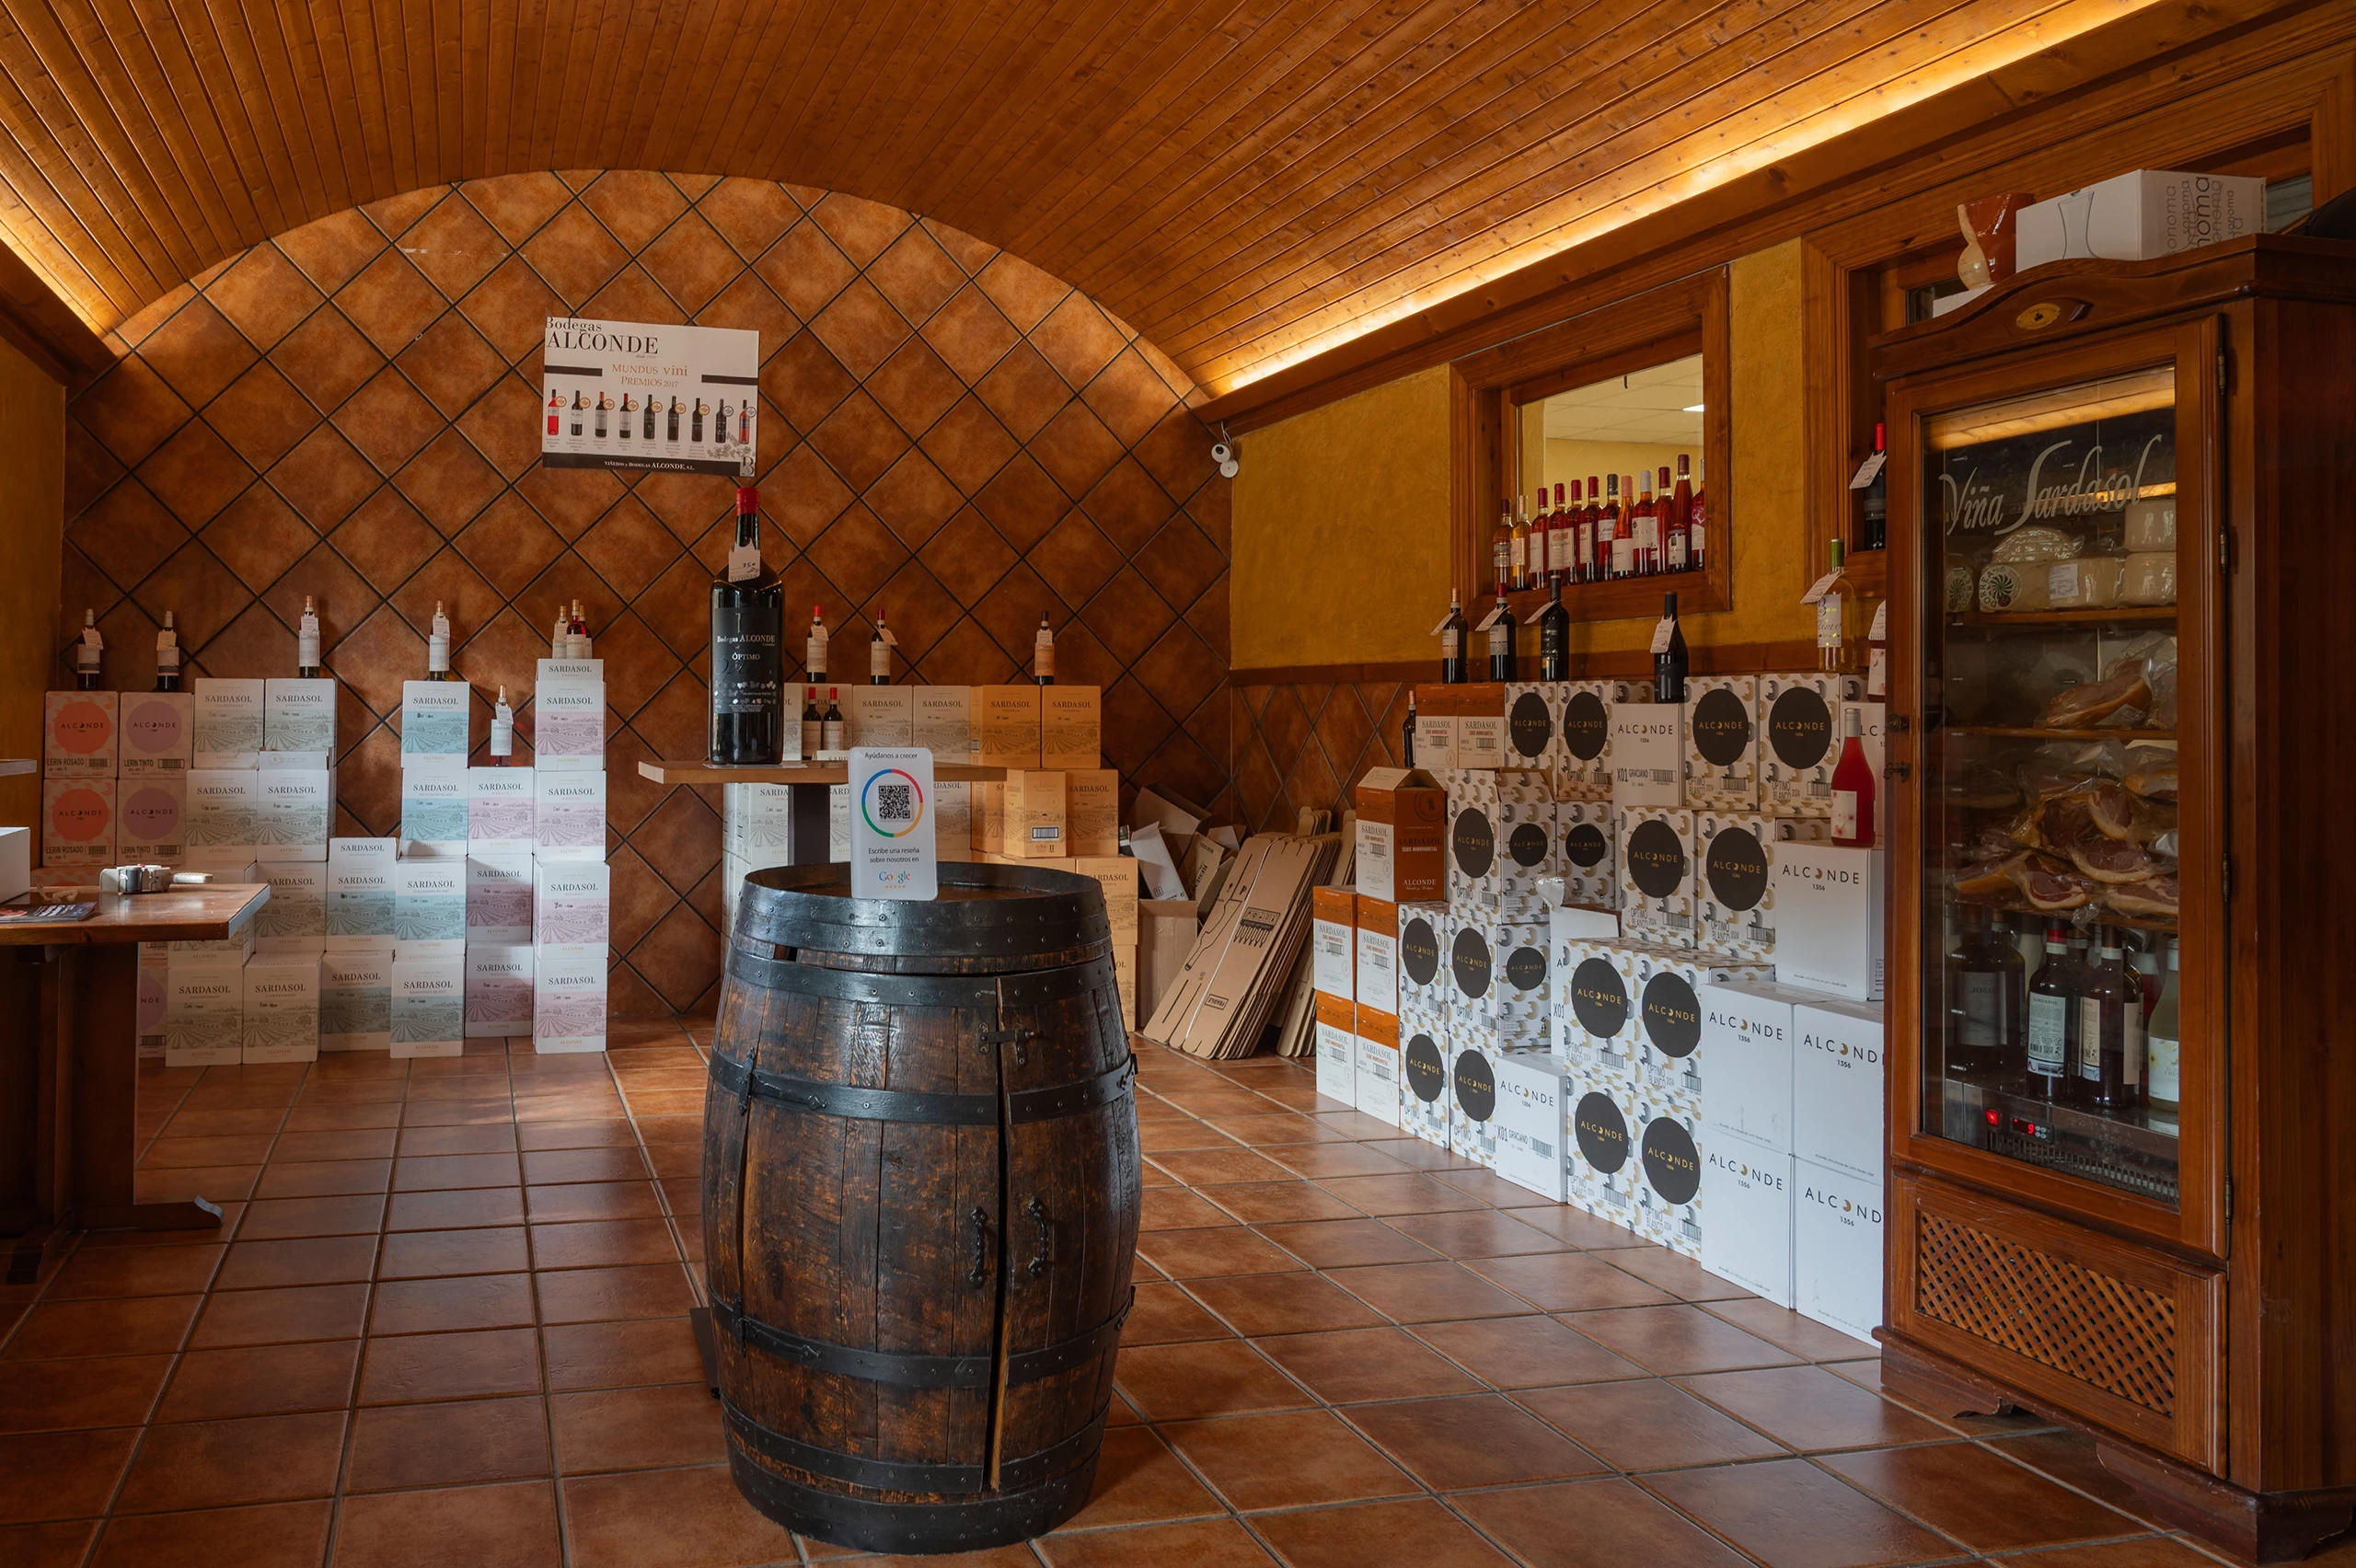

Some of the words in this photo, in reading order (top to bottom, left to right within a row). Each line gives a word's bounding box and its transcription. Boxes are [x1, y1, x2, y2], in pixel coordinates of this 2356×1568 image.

[546, 317, 602, 334] Bodegas
[547, 331, 658, 354] ALCONDE
[612, 364, 658, 374] MUNDUS
[664, 365, 687, 375] vini
[621, 376, 662, 386] PREMIOS
[1939, 467, 2004, 536] Viña
[1994, 434, 2162, 535] Sardasol
[717, 636, 738, 644] Bodegas
[733, 651, 760, 660] ÓPTIMO
[205, 695, 252, 703] SARDASOL
[276, 695, 322, 703] SARDASOL
[1422, 721, 1451, 729] SARDASOL
[1618, 724, 1672, 734] ALCONDE
[1776, 722, 1824, 731] ALCONDE
[1617, 768, 1627, 782] X01
[1629, 769, 1648, 778] GRACIANO
[197, 787, 246, 795] SARDASOL
[1690, 787, 1705, 795] BLANCO
[1772, 781, 1790, 790] OPTIMO
[1773, 791, 1791, 801] BLANCO
[1362, 824, 1388, 836] SARDASOL
[1457, 836, 1489, 847] ALCONDE
[1634, 851, 1677, 862] ALCONDE
[1714, 860, 1760, 873] ALCONDE
[879, 871, 910, 883] Google
[1783, 865, 1859, 884] ALCONDE
[267, 878, 315, 886] SARDASOL
[1631, 908, 1647, 918] OPTIMO
[1632, 918, 1647, 928] BLANCO
[1711, 922, 1729, 932] OPTIMO
[1319, 925, 1346, 938] SARDASOL
[1712, 931, 1729, 942] BLANCO
[1363, 934, 1390, 949] SARDASOL
[1406, 944, 1434, 956] ALCONDE
[1457, 955, 1486, 968] ALCONDE
[332, 973, 381, 981] SARDASOL
[179, 986, 230, 994] SARDASOL
[255, 984, 306, 993] SARDASOL
[1577, 988, 1621, 1004] ALCONDE
[1648, 1004, 1694, 1022] ALCONDE
[1709, 1012, 1783, 1041] ALCONDE
[1322, 1028, 1348, 1044] SARDASOL
[1738, 1034, 1750, 1043] 1356
[1362, 1043, 1392, 1060] SARDASOL
[1804, 1035, 1883, 1065] ALCOND
[1410, 1059, 1439, 1074] ALCONDE
[1837, 1060, 1851, 1068] 1356
[1459, 1076, 1491, 1092] ALCONDE
[1501, 1081, 1553, 1106] ALCONDE
[1497, 1124, 1507, 1142] X01
[1509, 1130, 1528, 1144] GRACIANO
[1581, 1121, 1623, 1141] ALCONDE
[1648, 1147, 1693, 1170] ALCONDE
[1709, 1154, 1782, 1191] ALCONDE
[1738, 1180, 1750, 1189] 1356
[1805, 1188, 1882, 1223] ALCOND
[1840, 1216, 1854, 1227] 1356
